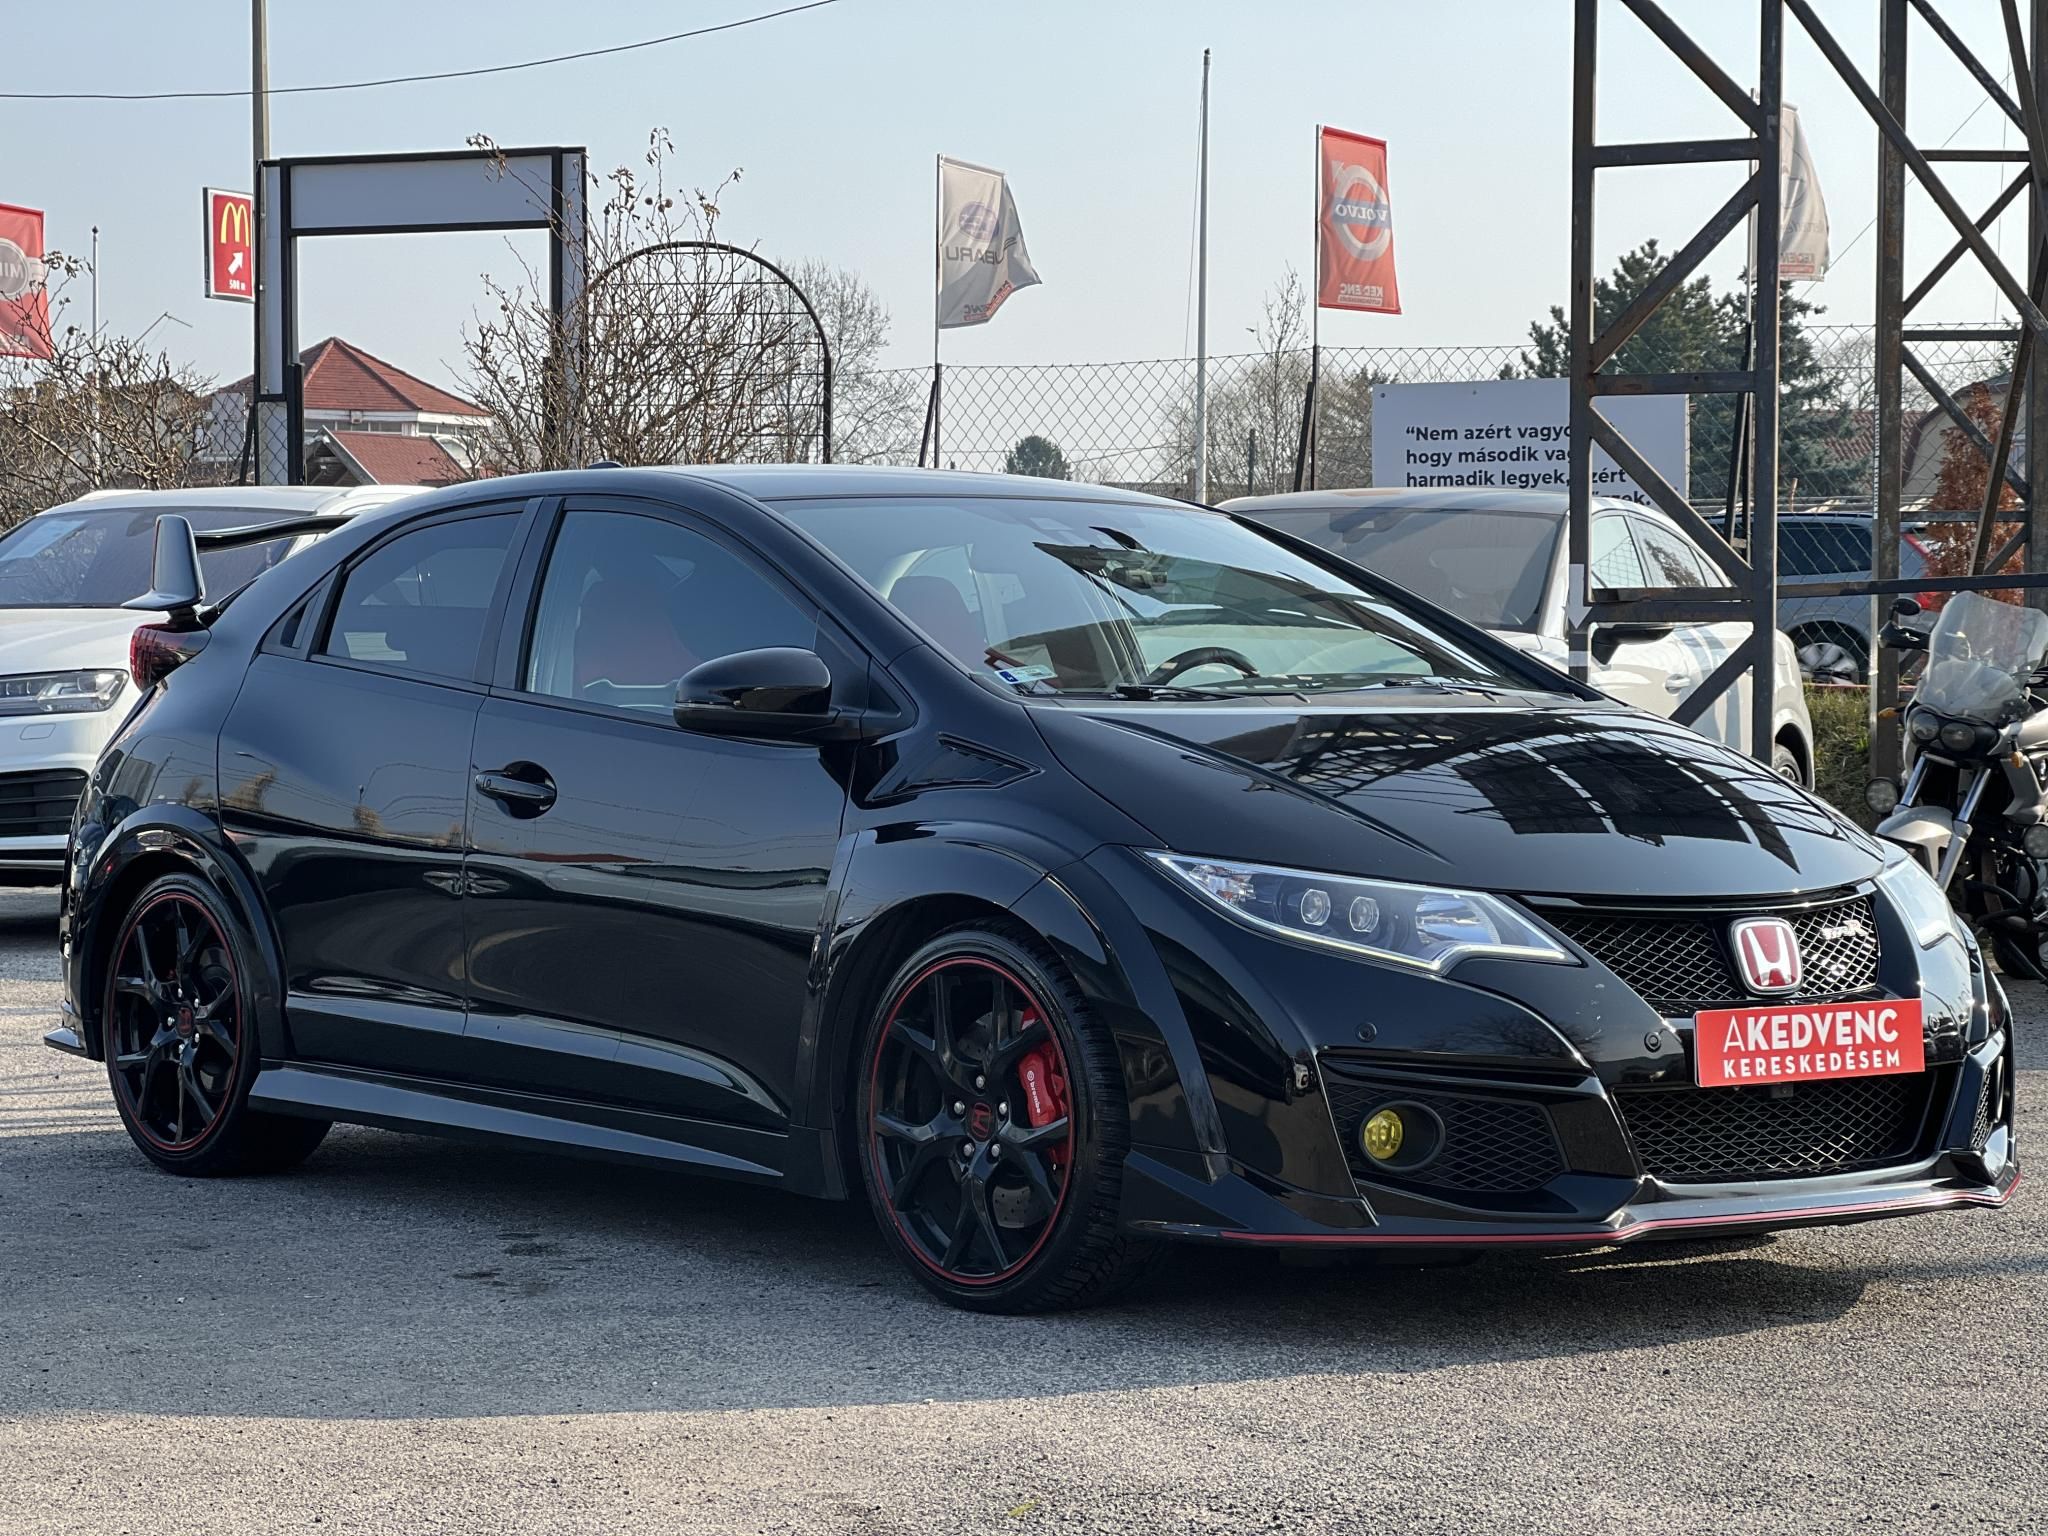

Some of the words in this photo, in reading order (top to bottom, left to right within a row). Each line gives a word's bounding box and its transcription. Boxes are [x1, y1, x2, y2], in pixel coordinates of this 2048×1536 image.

[1464, 424, 1512, 440] azért
[1517, 425, 1570, 442] vagyo
[1406, 449, 1453, 468] hogy
[1458, 446, 1539, 463] második
[1406, 470, 1495, 488] harmadik
[1501, 469, 1570, 489] legyek,
[1592, 467, 1627, 483] zért
[1723, 1047, 1901, 1079] KERESKEDÉSEM
